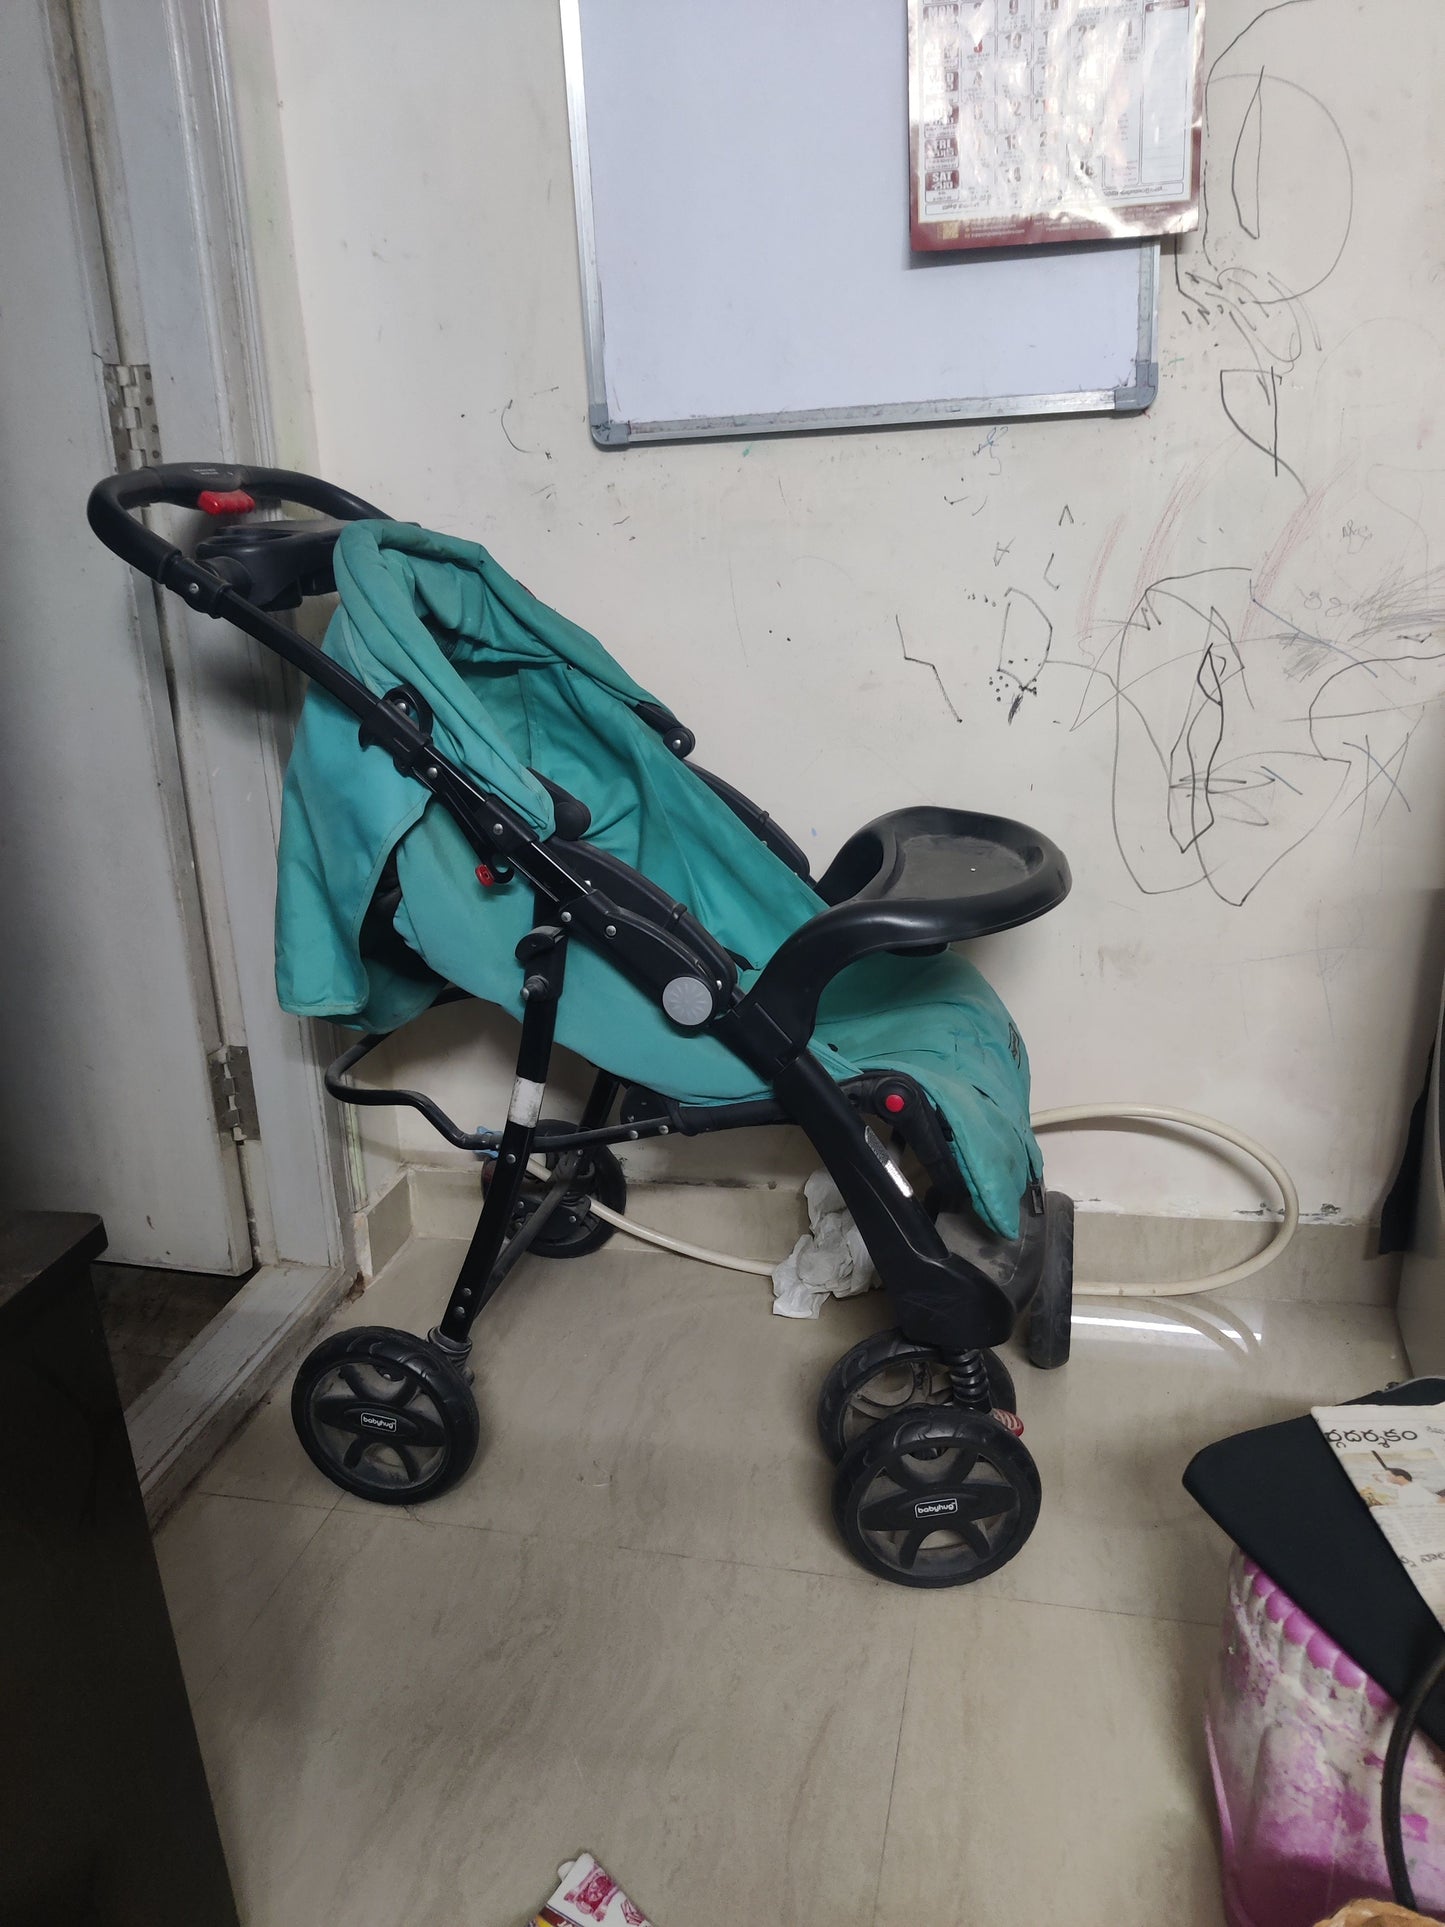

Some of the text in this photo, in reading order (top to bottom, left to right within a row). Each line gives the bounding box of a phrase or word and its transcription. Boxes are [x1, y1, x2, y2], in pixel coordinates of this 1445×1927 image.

[932, 171, 952, 182] SAT
[362, 1415, 394, 1430] babyhug
[917, 1503, 955, 1514] babyhug
